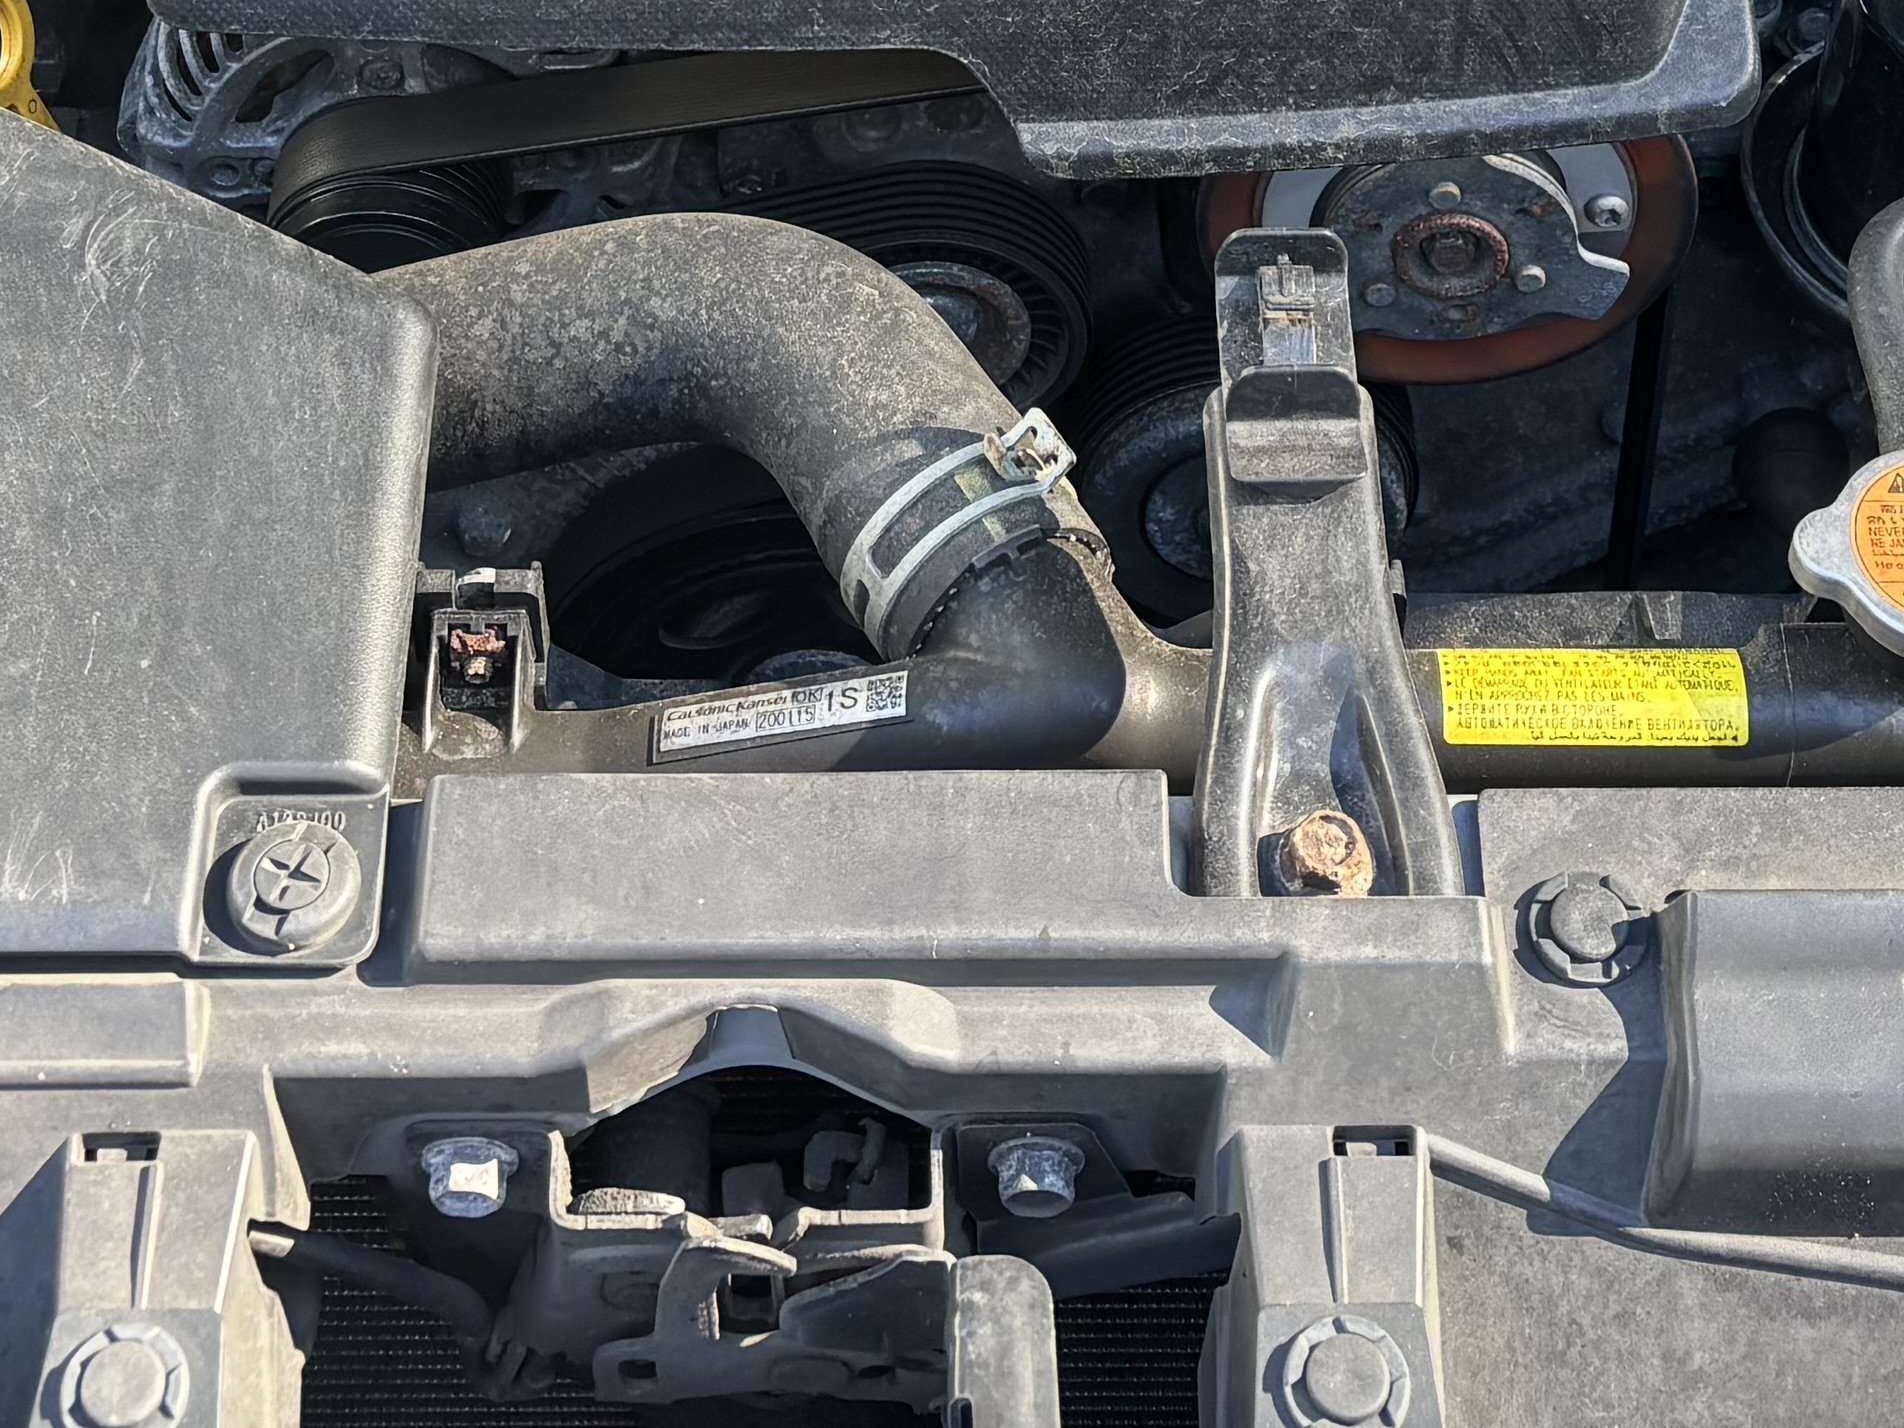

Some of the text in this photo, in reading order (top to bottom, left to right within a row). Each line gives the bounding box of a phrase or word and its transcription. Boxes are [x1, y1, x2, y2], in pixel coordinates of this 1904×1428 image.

[1870, 537, 1884, 548] NE
[1874, 560, 1893, 569] Не
[792, 687, 821, 704] OK
[662, 725, 691, 740] MADE
[696, 723, 709, 735] IN
[757, 706, 814, 730] 200115
